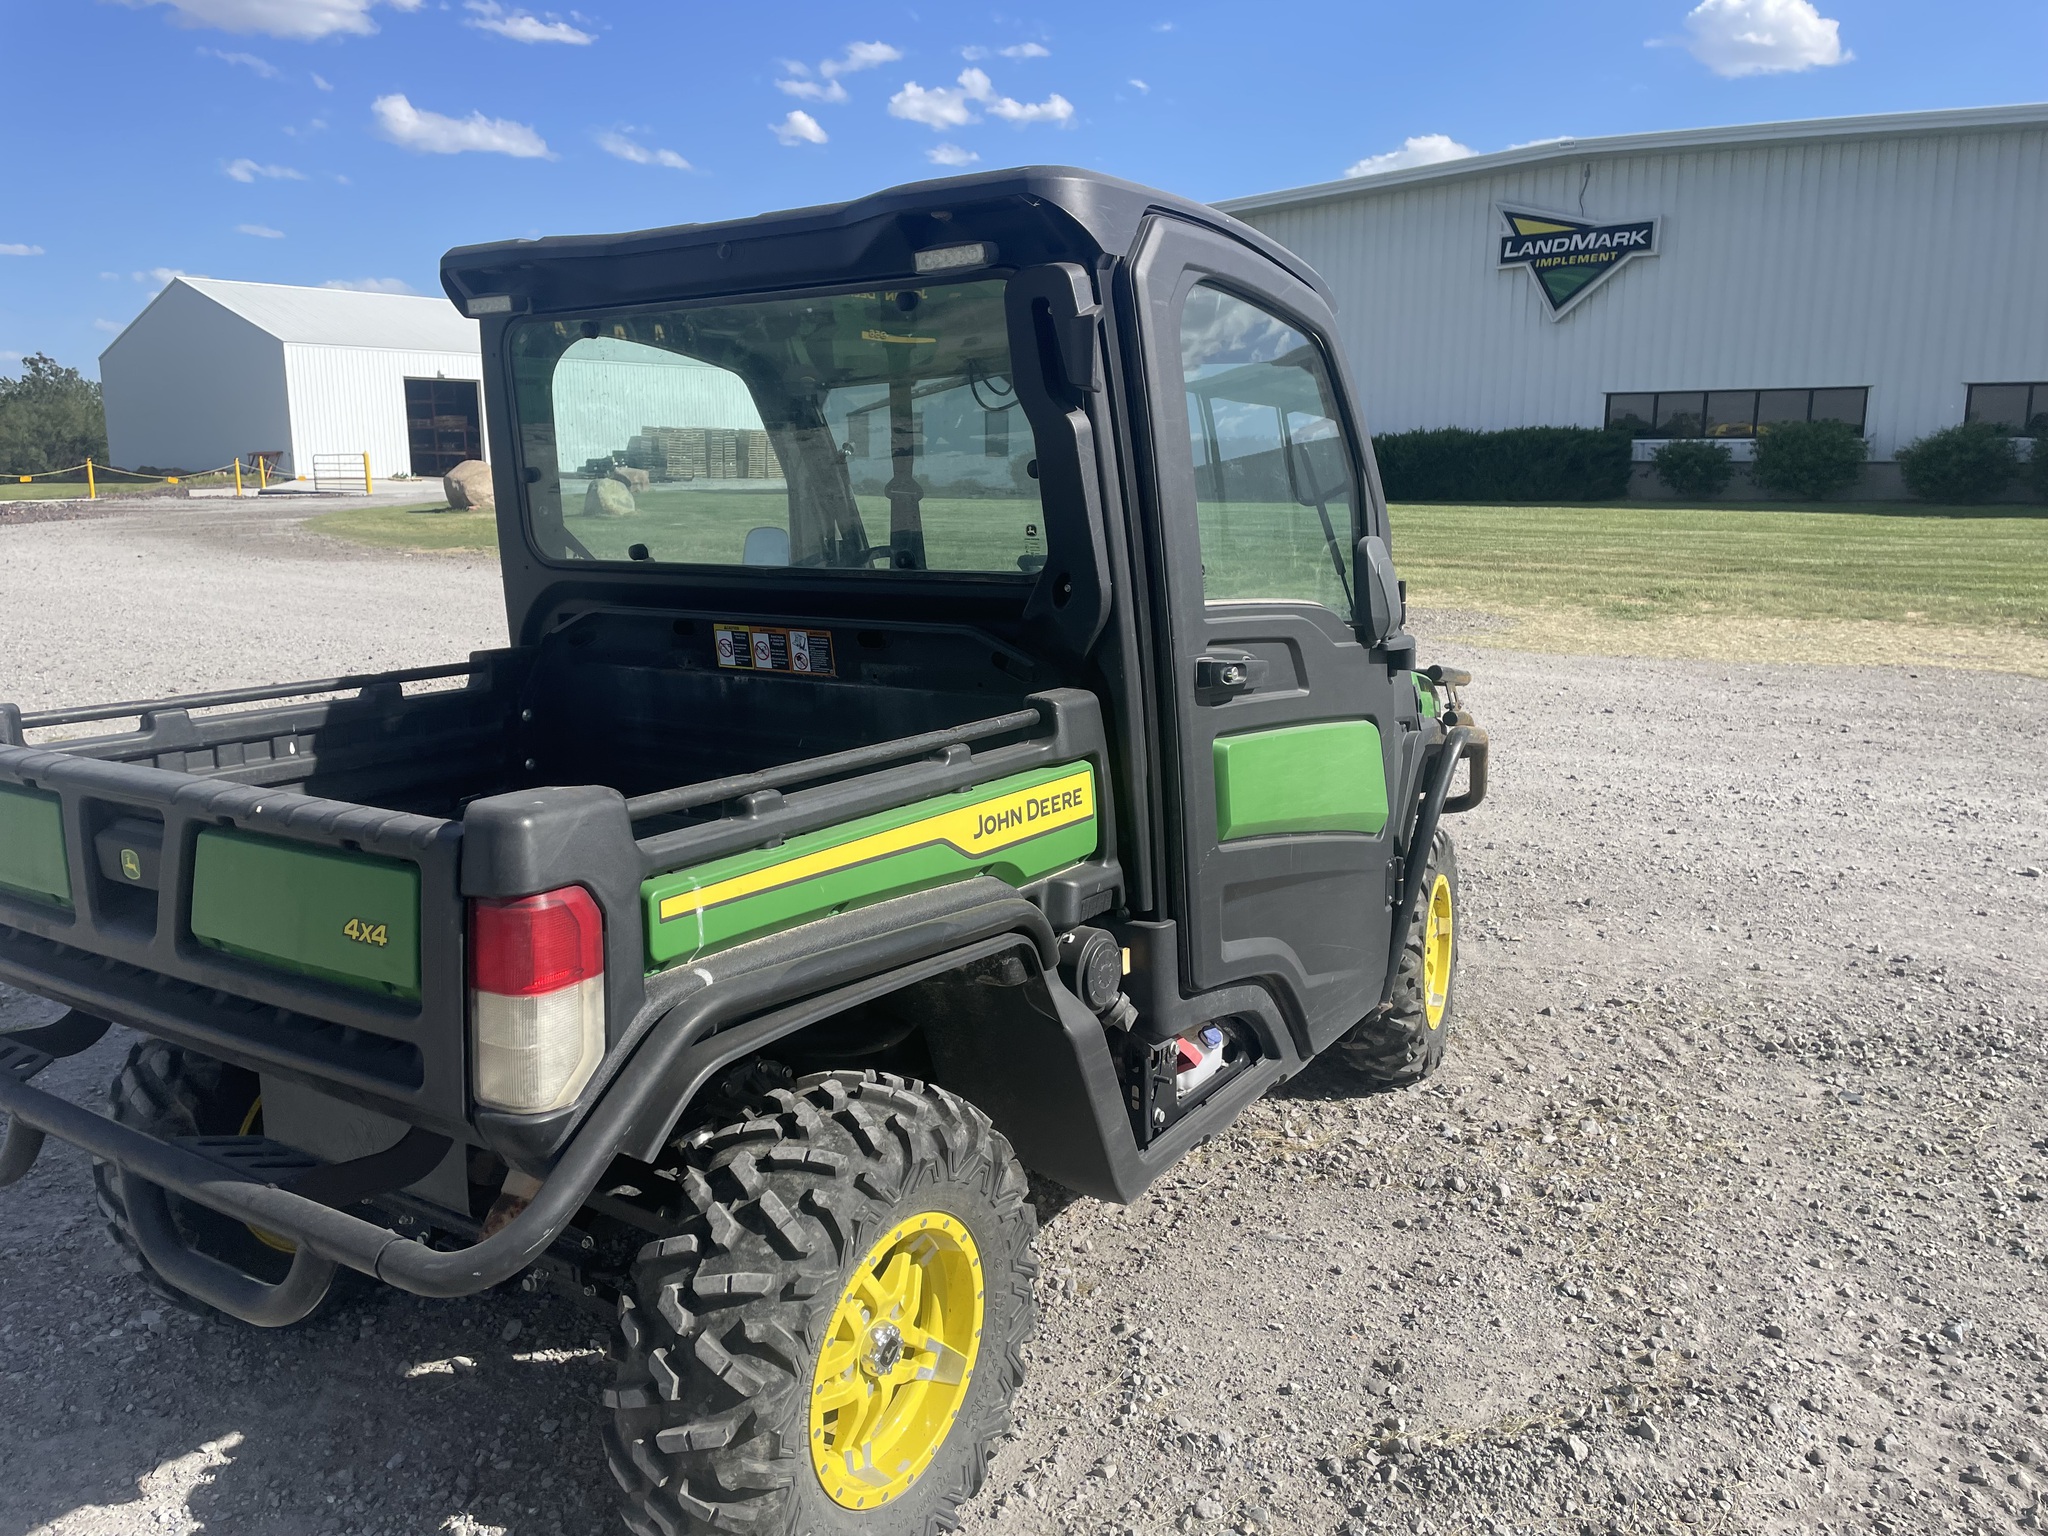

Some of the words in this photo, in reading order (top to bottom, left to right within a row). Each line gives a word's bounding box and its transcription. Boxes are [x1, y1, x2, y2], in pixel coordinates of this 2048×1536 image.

[1535, 251, 1618, 268] IMPLEMENT
[973, 806, 1023, 840] JOHN
[1026, 787, 1083, 822] DEERE
